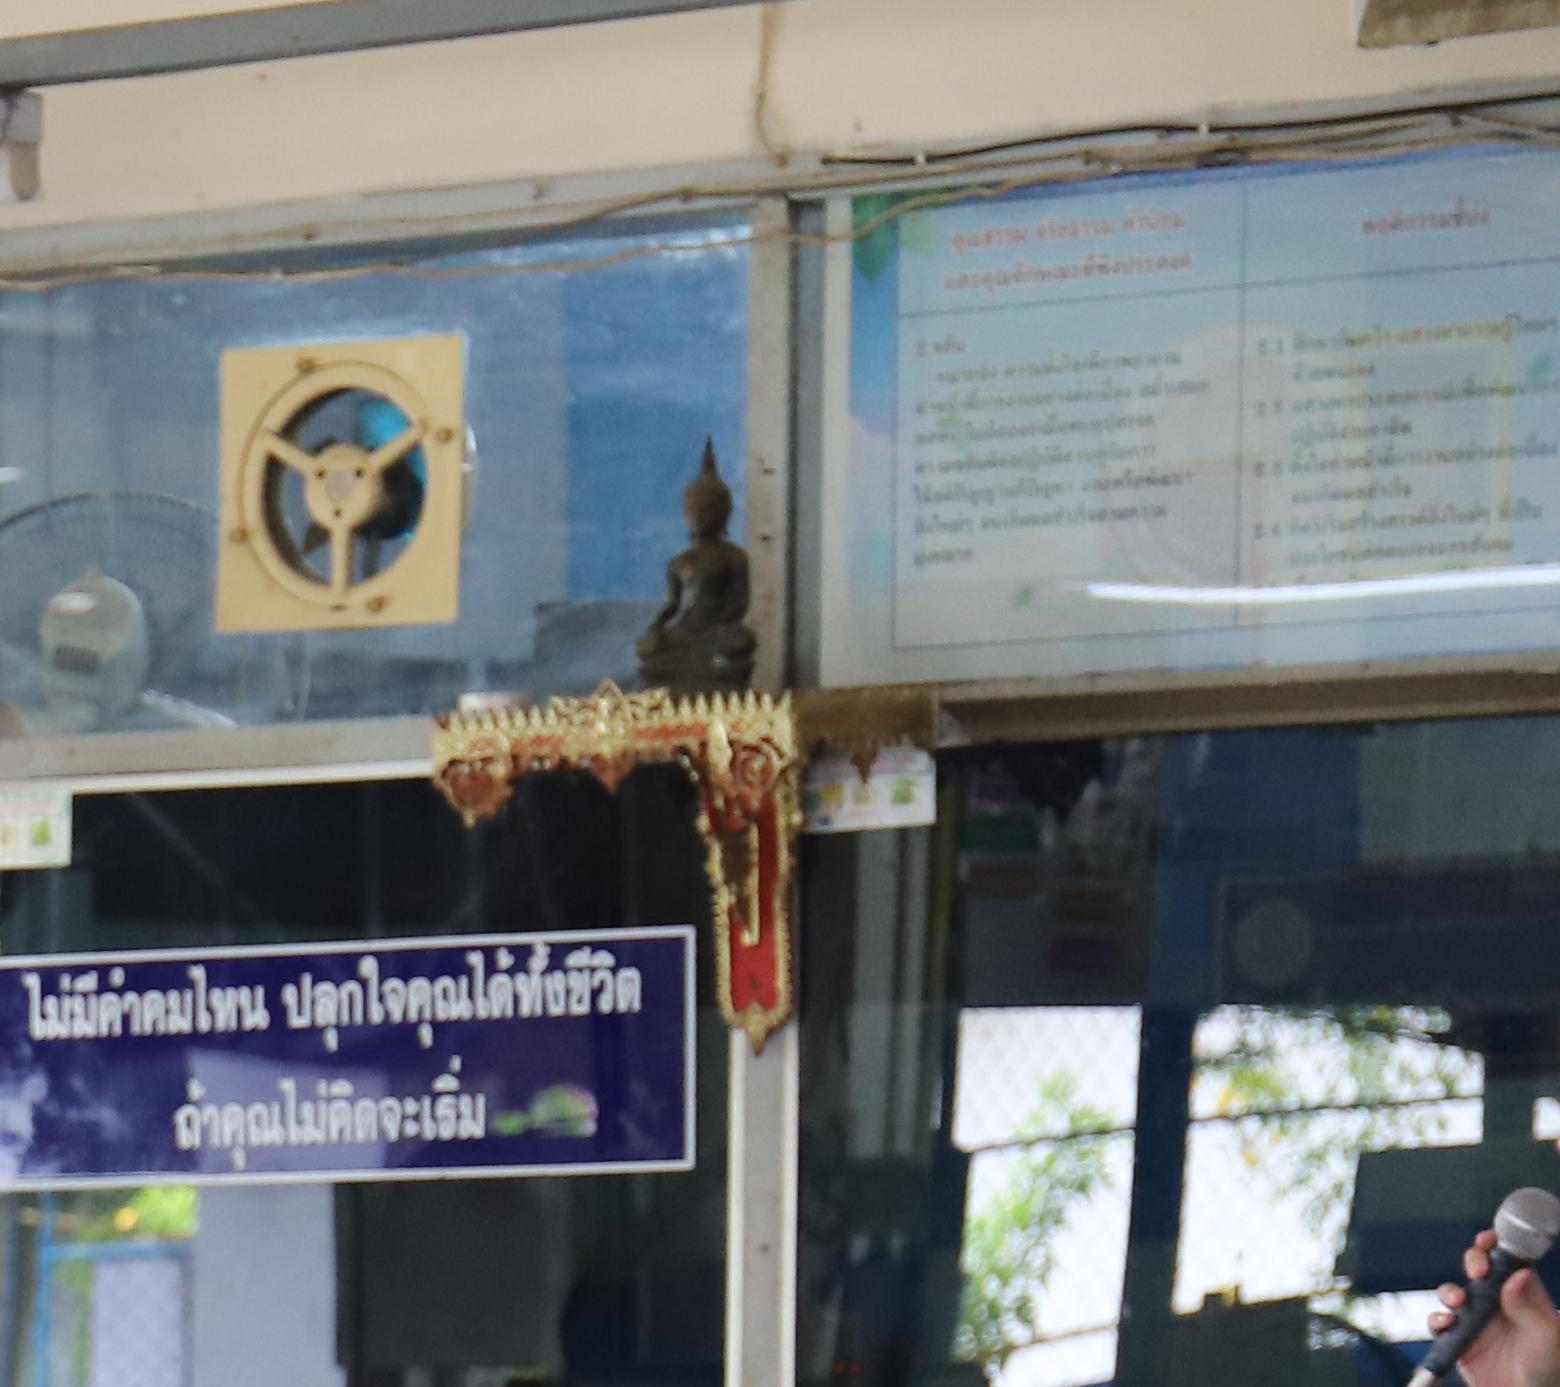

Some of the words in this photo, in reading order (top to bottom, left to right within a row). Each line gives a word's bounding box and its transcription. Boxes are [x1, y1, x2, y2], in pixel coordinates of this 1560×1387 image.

[22, 963, 271, 1041] ไม่มีคำคมไหน
[281, 941, 642, 1052] ปลุกใจคุณได้ทั้งชีวิต
[175, 1055, 486, 1171] ถ้าคุณไม่คิดจะเริ่ม
